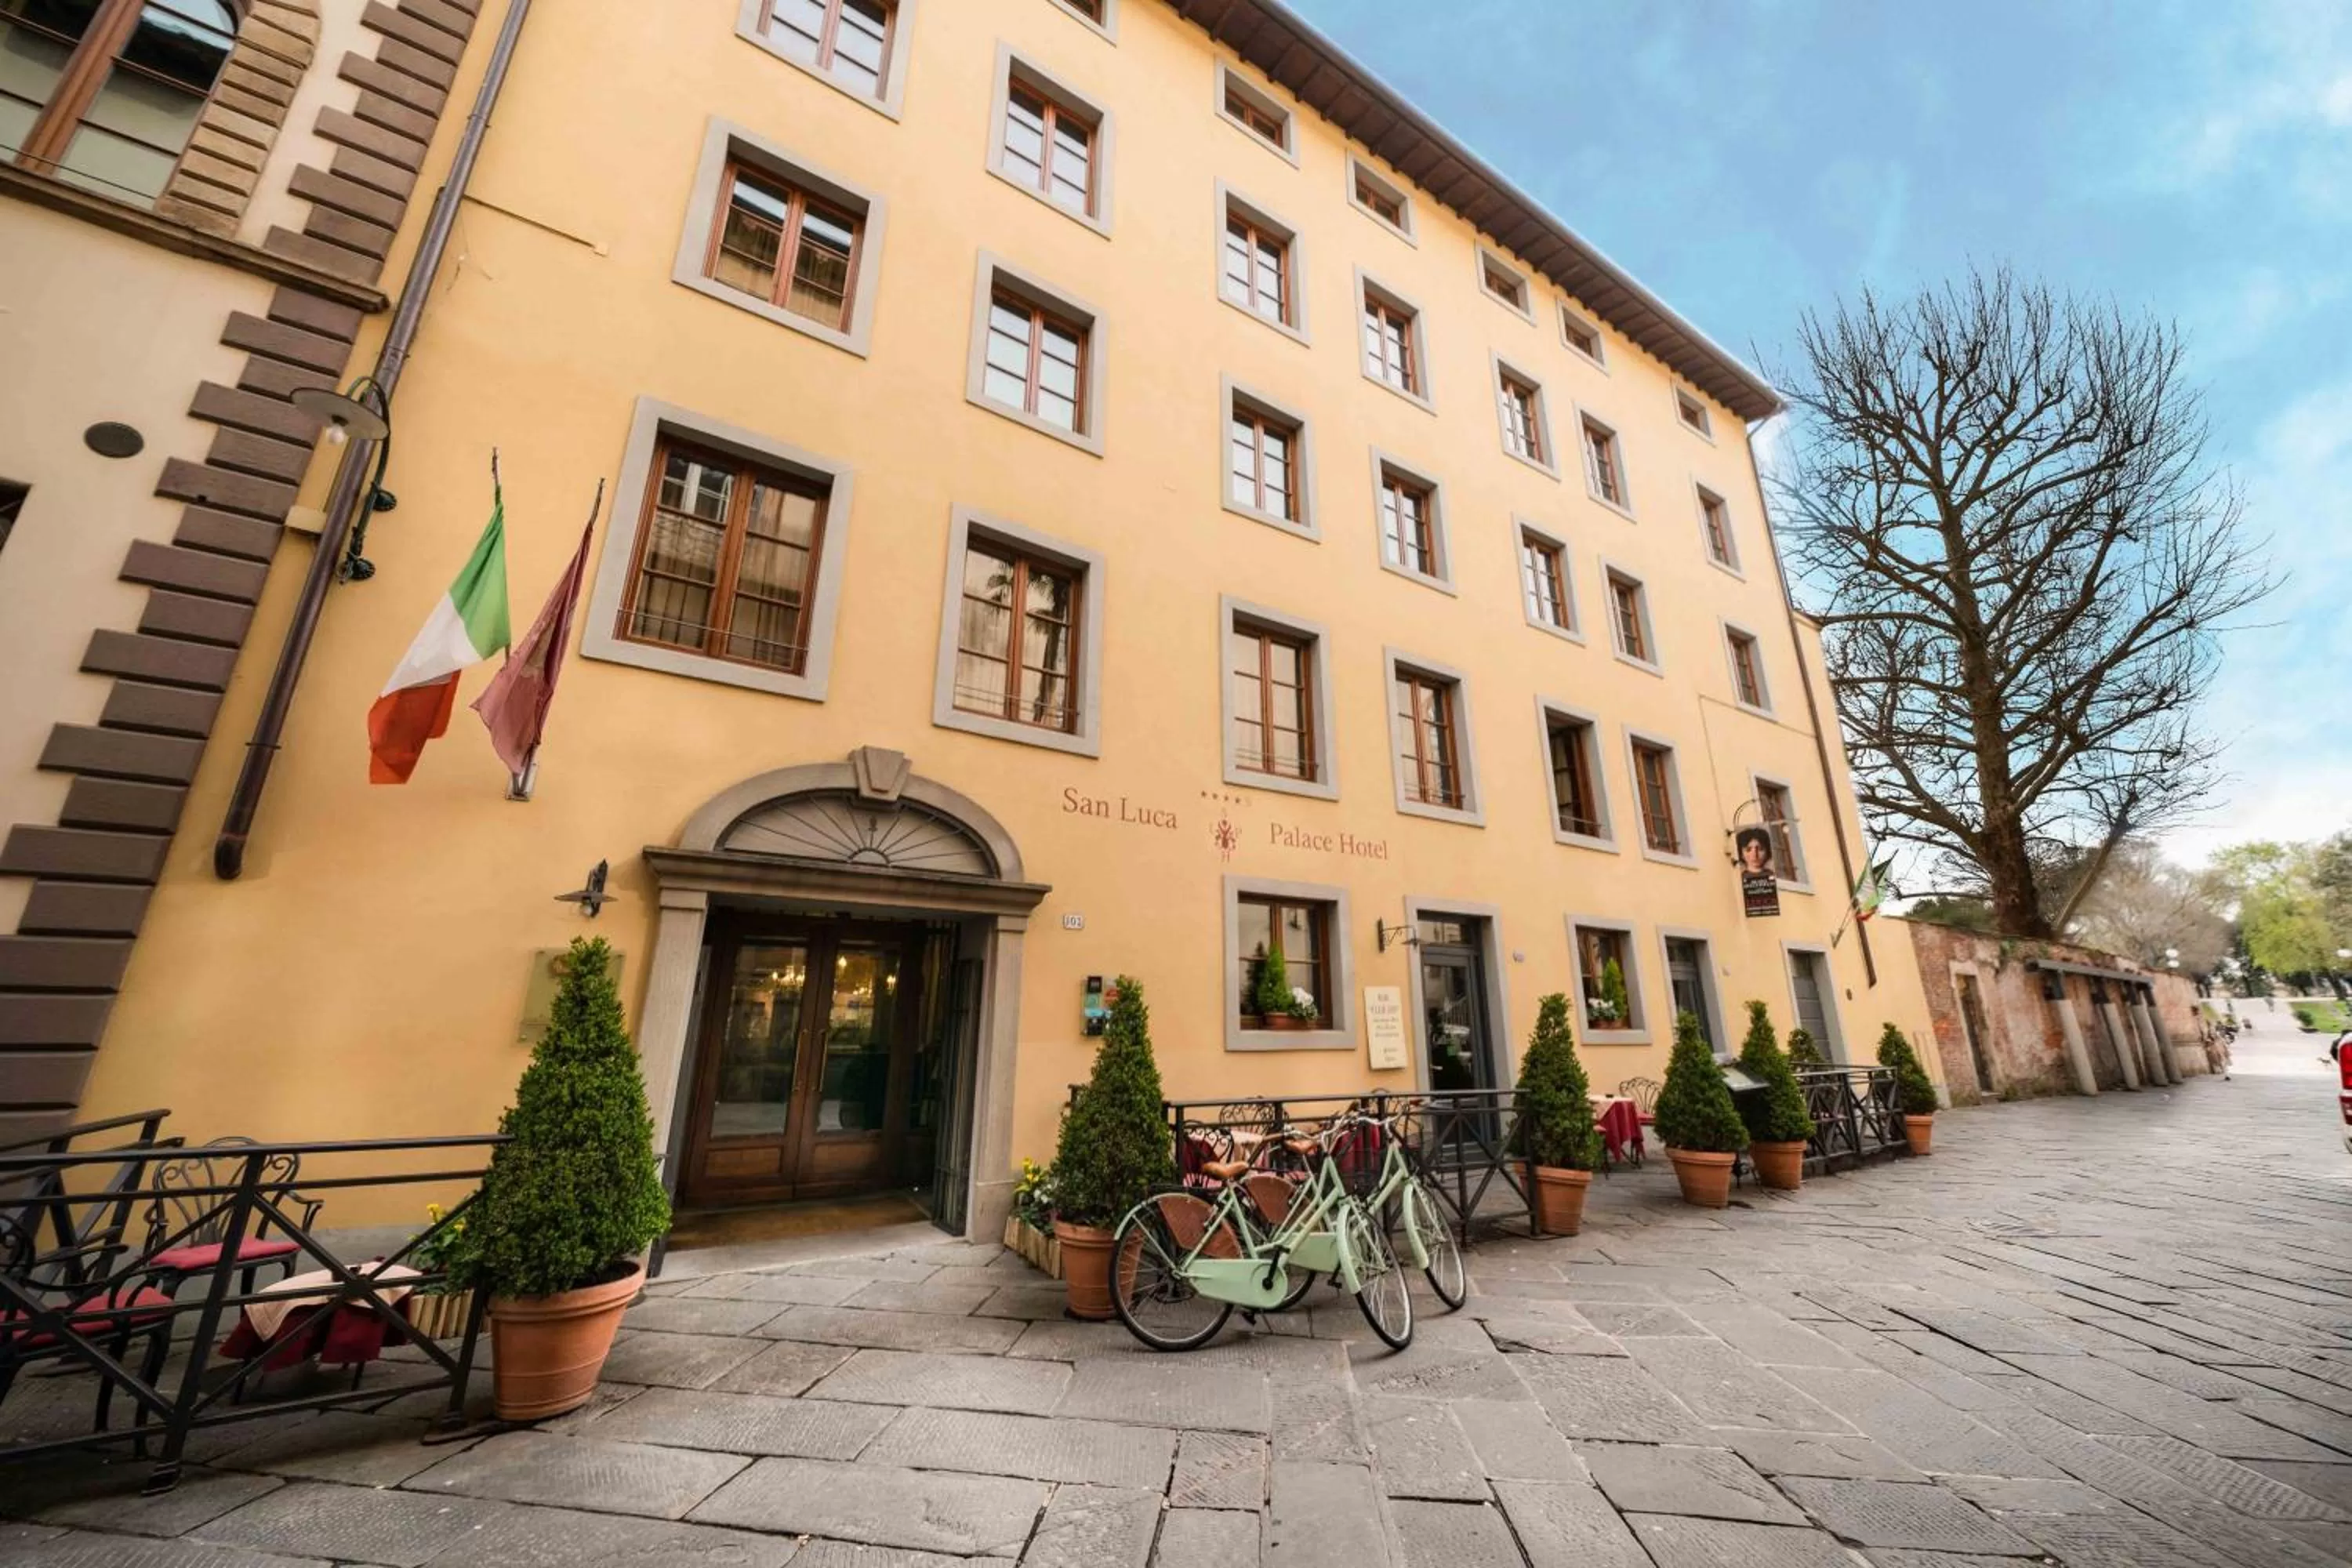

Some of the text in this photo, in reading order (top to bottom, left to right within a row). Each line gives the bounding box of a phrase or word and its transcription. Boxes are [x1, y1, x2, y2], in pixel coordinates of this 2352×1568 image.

[1062, 786, 1178, 829] San Luca
[1270, 822, 1388, 860] Palace Hotel
